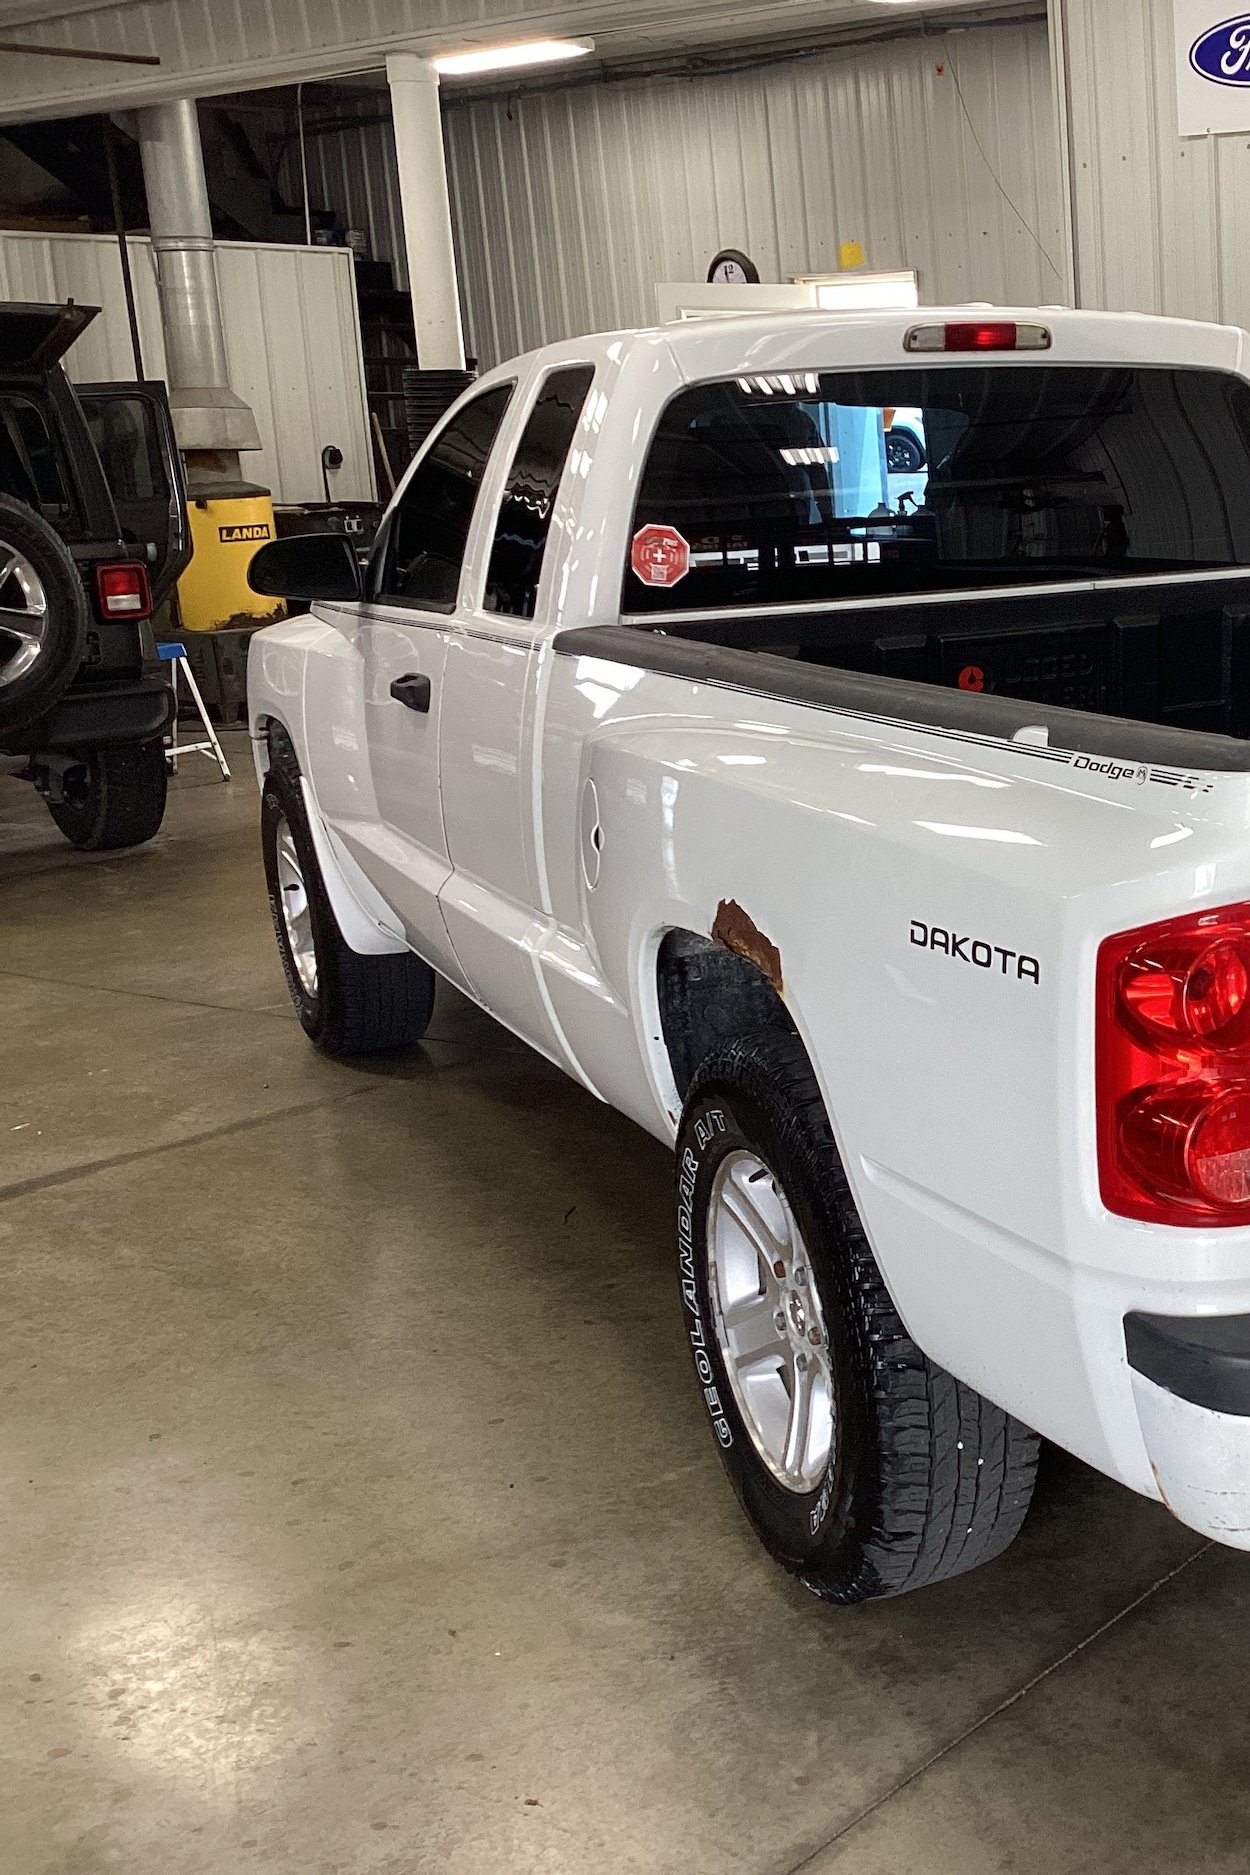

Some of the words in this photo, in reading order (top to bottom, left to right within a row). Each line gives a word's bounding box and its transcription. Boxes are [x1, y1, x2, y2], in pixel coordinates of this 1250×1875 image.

[221, 527, 269, 540] LANDA
[1073, 755, 1134, 780] Dodge
[910, 920, 1040, 985] DAKOTA
[676, 1146, 734, 1448] GEOLANDAR
